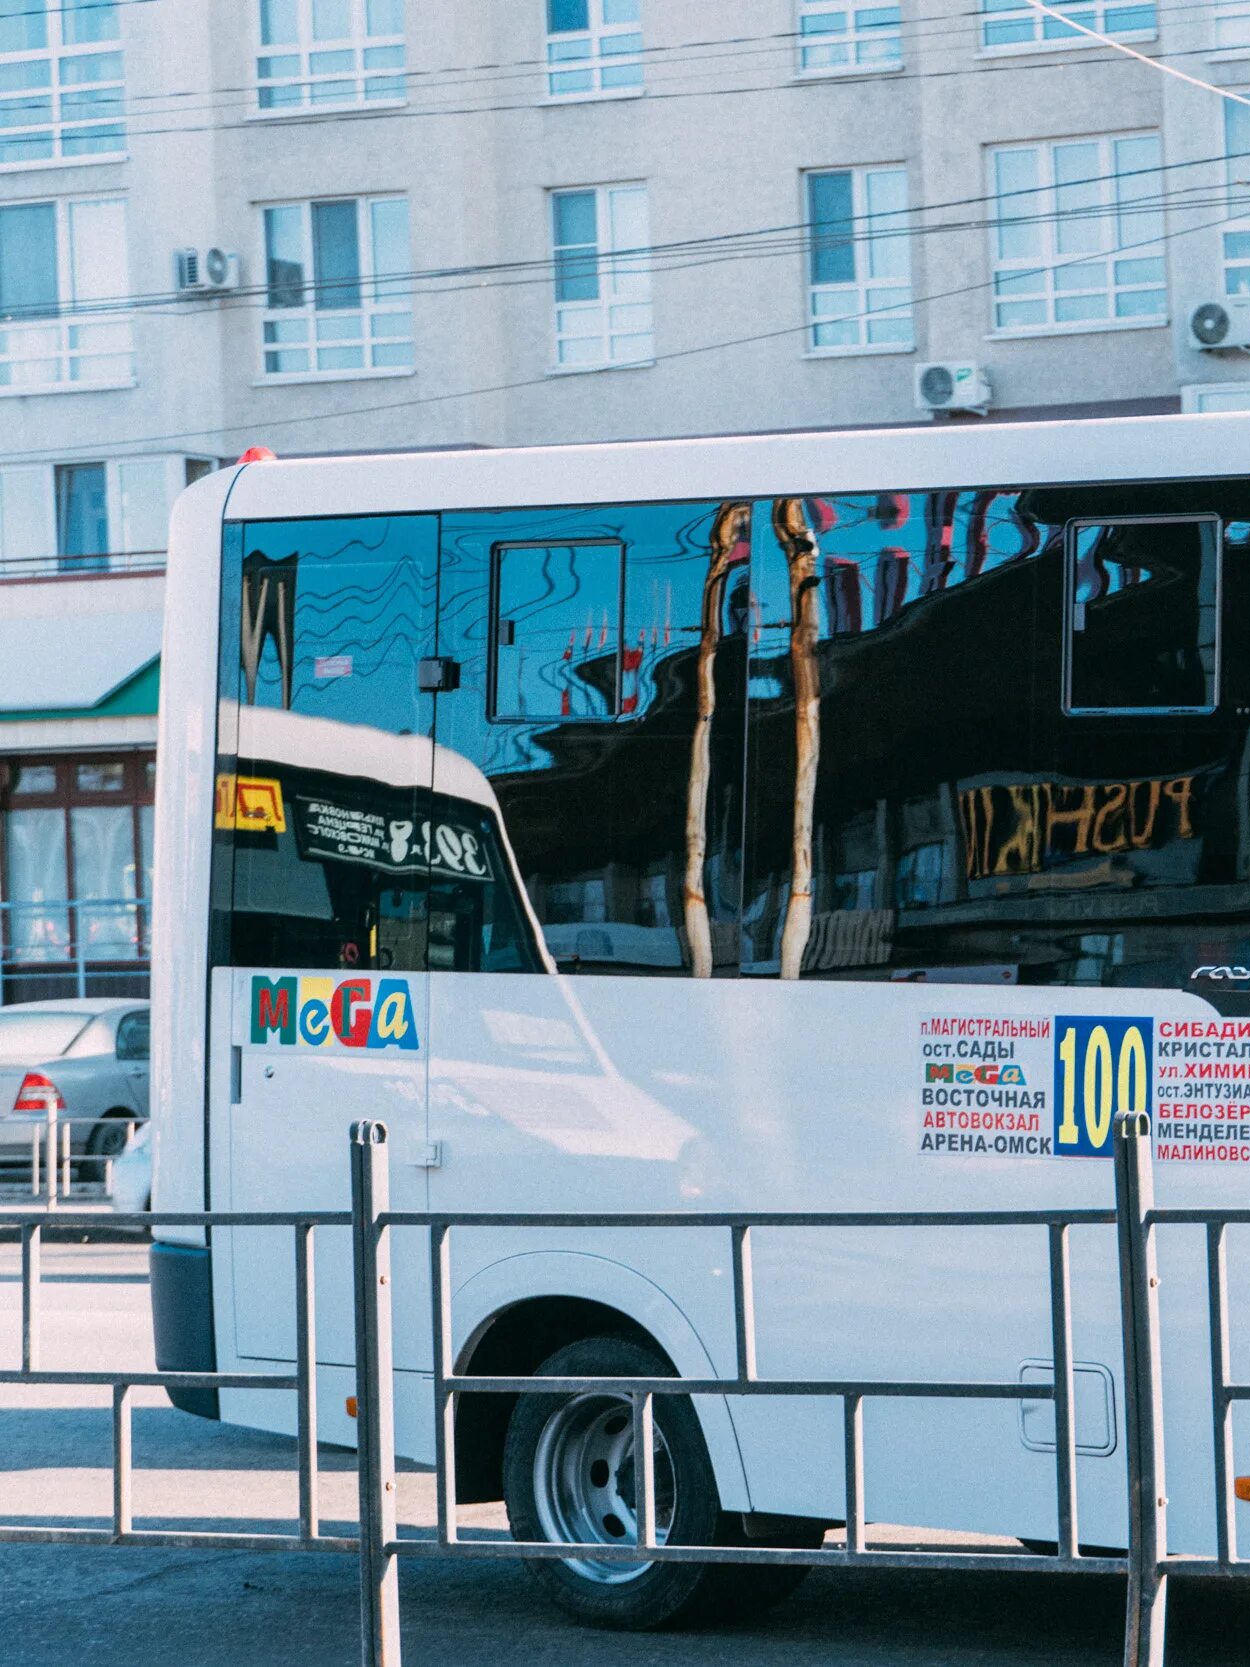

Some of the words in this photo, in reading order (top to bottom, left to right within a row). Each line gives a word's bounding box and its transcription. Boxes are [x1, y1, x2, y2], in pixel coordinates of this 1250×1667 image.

[921, 1017, 1050, 1038] п.МАГИСТРАЛЬНЫЙ
[922, 1040, 1014, 1061] ост.САДЫ
[1058, 1025, 1148, 1149] 100
[922, 1088, 1046, 1108] ВОСТОЧНАЯ
[923, 1111, 1039, 1131] АВТОВОКЗАЛ
[921, 1133, 1052, 1155] АРЕНА-ОМСК
